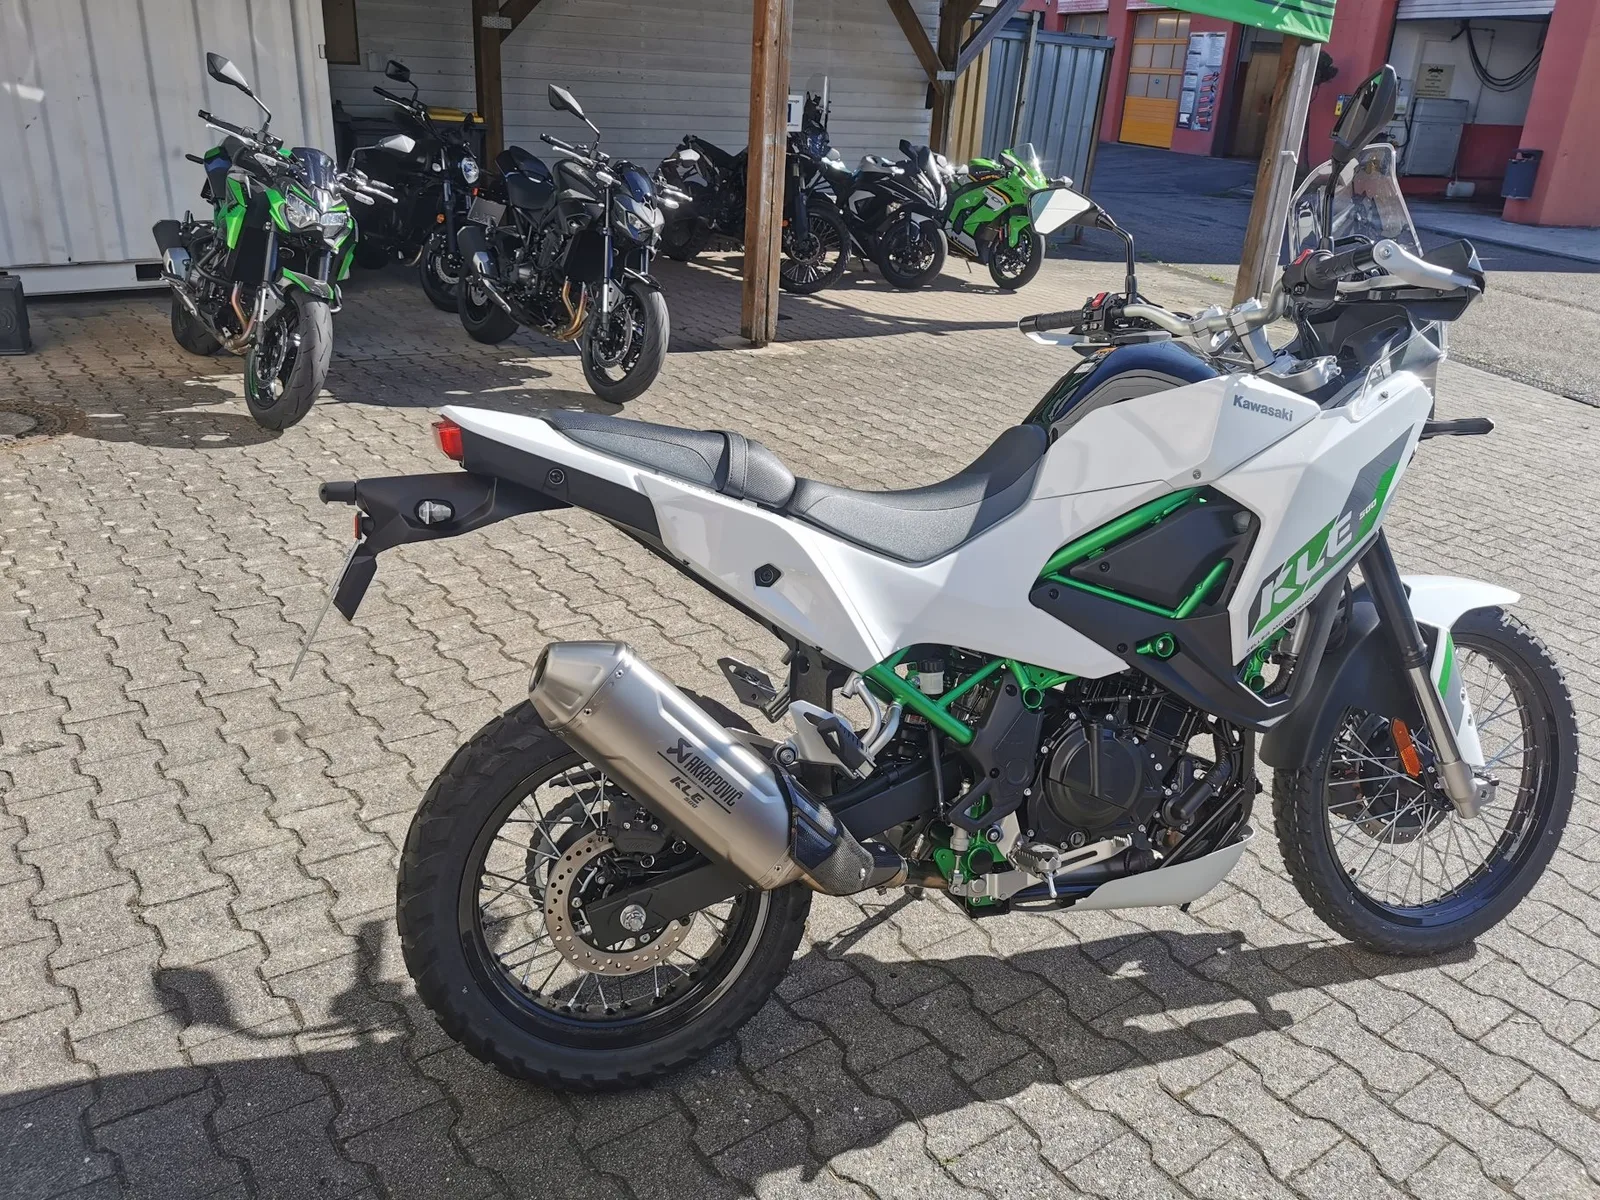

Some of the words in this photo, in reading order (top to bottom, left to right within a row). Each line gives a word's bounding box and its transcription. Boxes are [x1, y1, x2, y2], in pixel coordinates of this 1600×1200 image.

[1233, 394, 1293, 422] Kawasaki
[1259, 511, 1352, 621] KLE
[1359, 498, 1377, 521] 500
[669, 776, 705, 804] KLE
[684, 756, 744, 807] AKRAPOVIČ
